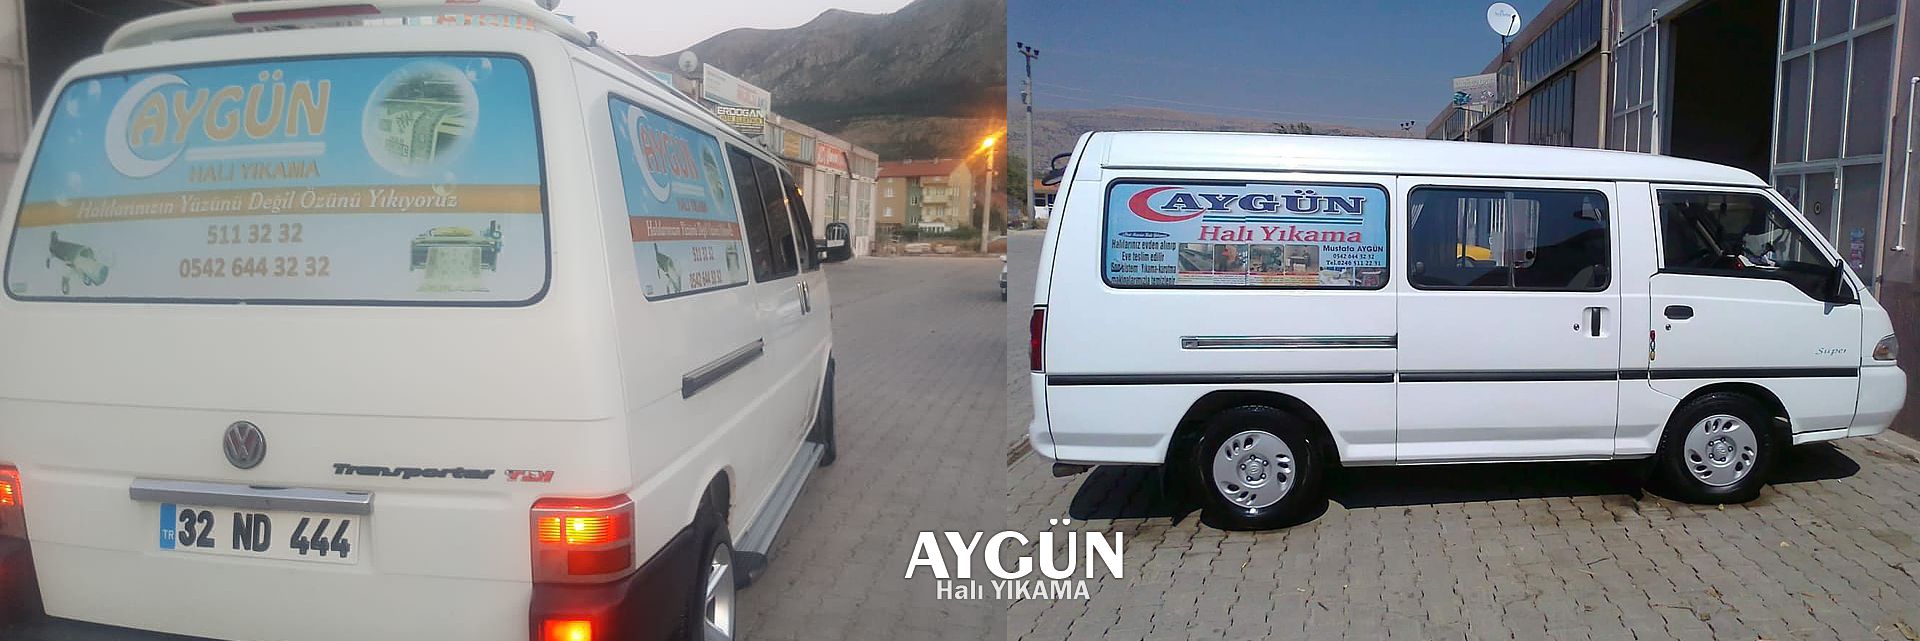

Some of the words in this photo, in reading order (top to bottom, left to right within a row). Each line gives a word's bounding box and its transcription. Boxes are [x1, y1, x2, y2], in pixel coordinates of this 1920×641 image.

[130, 69, 331, 146] AYGÜN
[189, 162, 235, 183] HALI
[240, 159, 321, 181] YIKAMA
[180, 194, 242, 214] Yüzünü
[248, 190, 296, 214] Değil
[301, 186, 361, 209] Özünü
[367, 188, 458, 212] Yıkıyoruz
[1160, 189, 1365, 214] AYGÜN
[207, 223, 241, 245] 511
[248, 222, 273, 244] 32
[278, 222, 304, 244] 32
[1198, 225, 1253, 242] Halı
[1261, 226, 1362, 243] Yıkama
[179, 257, 226, 278] 0542
[232, 256, 268, 277] 644
[272, 256, 299, 277] 32
[304, 255, 331, 277] 32
[333, 463, 496, 480] Transporter
[161, 529, 175, 541] TR
[178, 508, 215, 548] 32
[232, 512, 272, 552] ND
[290, 517, 351, 558] 444
